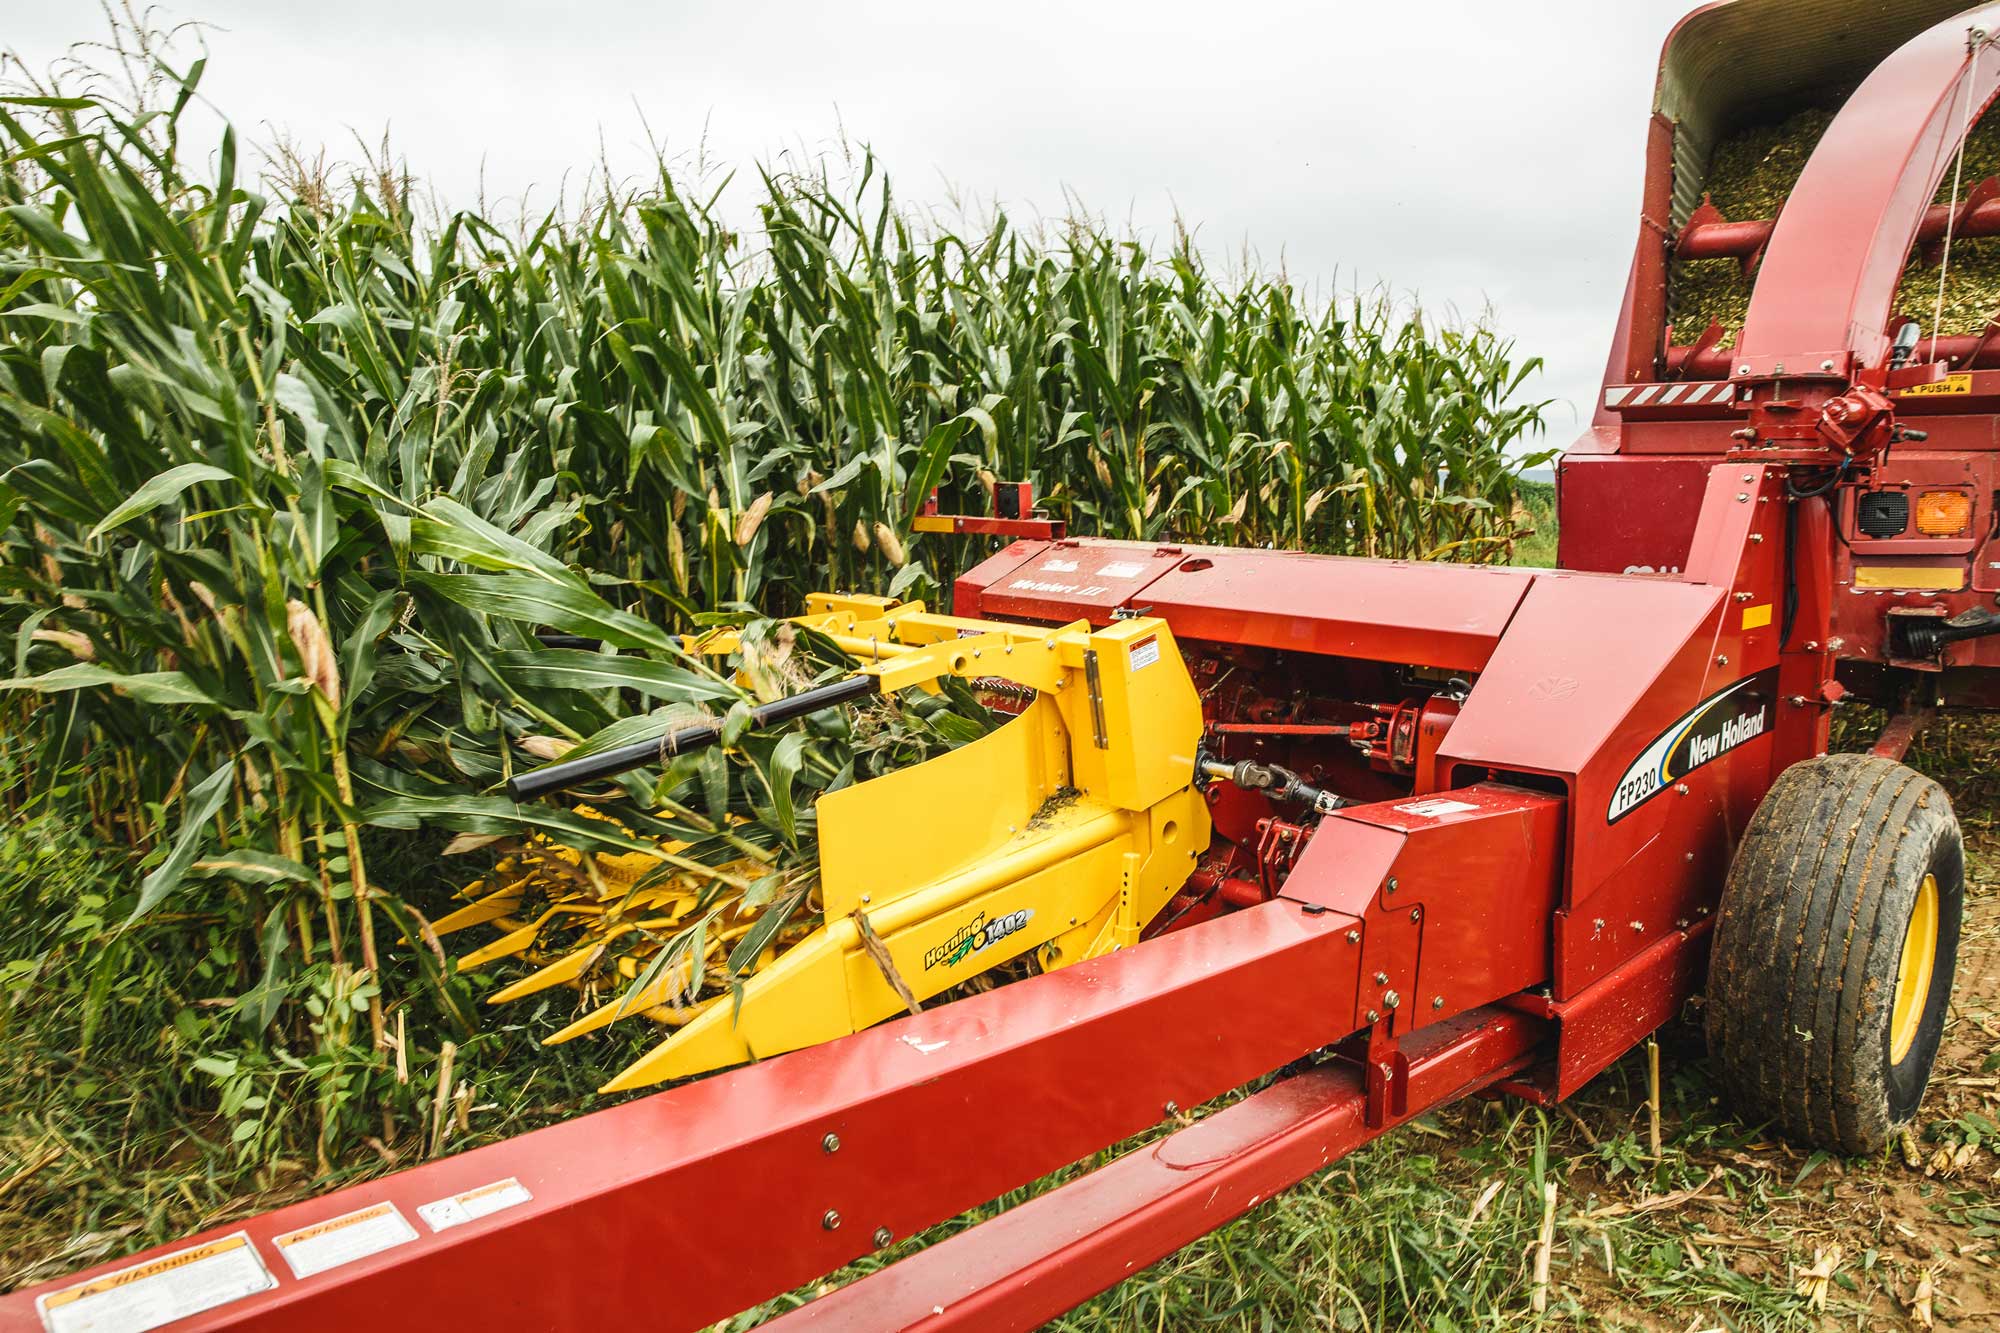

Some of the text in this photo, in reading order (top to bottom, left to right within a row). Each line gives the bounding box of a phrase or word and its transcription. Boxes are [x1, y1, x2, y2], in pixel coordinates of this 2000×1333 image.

[1920, 385, 1951, 393] PUSH
[1688, 704, 1766, 769] New Holland
[1619, 767, 1656, 811] FP230
[986, 910, 1027, 945] 1402
